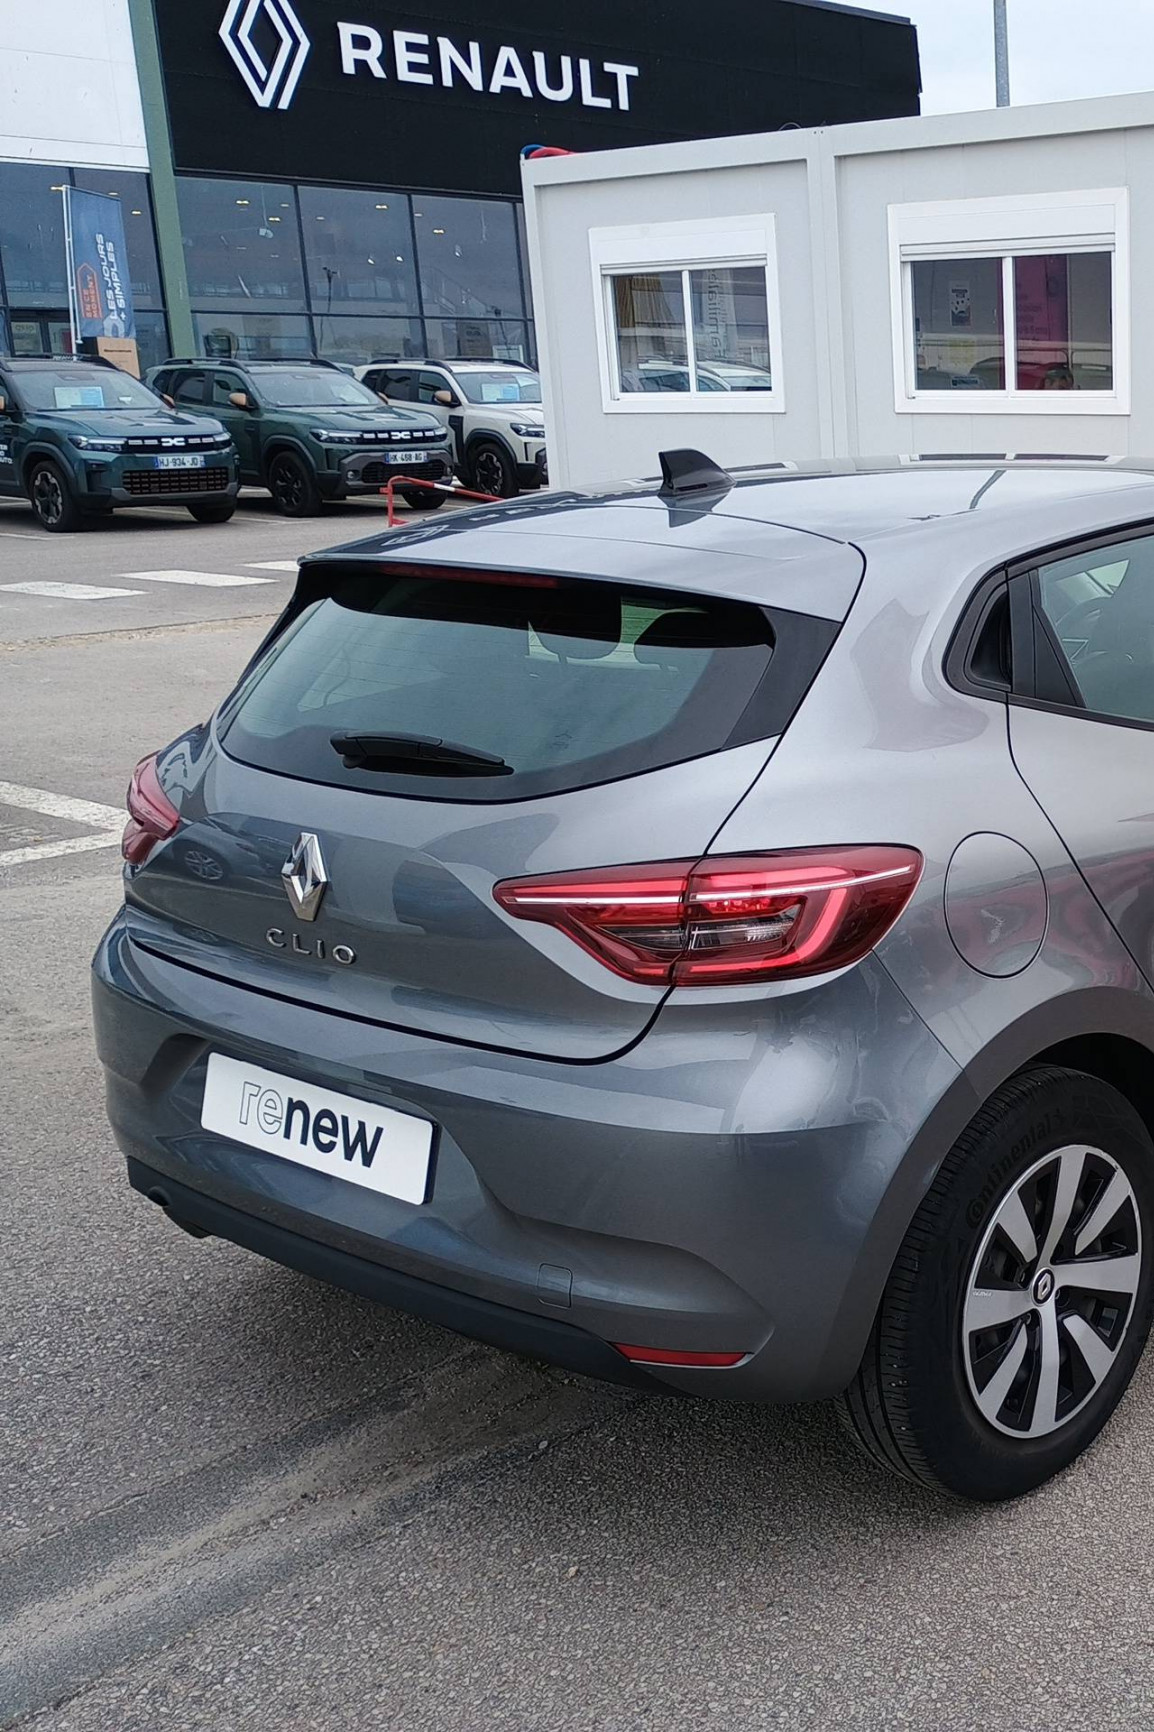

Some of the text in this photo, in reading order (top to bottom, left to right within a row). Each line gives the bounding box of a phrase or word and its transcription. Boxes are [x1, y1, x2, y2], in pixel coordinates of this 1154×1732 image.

[336, 21, 640, 111] RENAULT
[95, 233, 118, 320] LES JOURS
[105, 241, 126, 309] SIMPLES
[265, 927, 358, 966] CLIO
[237, 1080, 384, 1168] renew
[965, 1113, 1052, 1230] Continental
